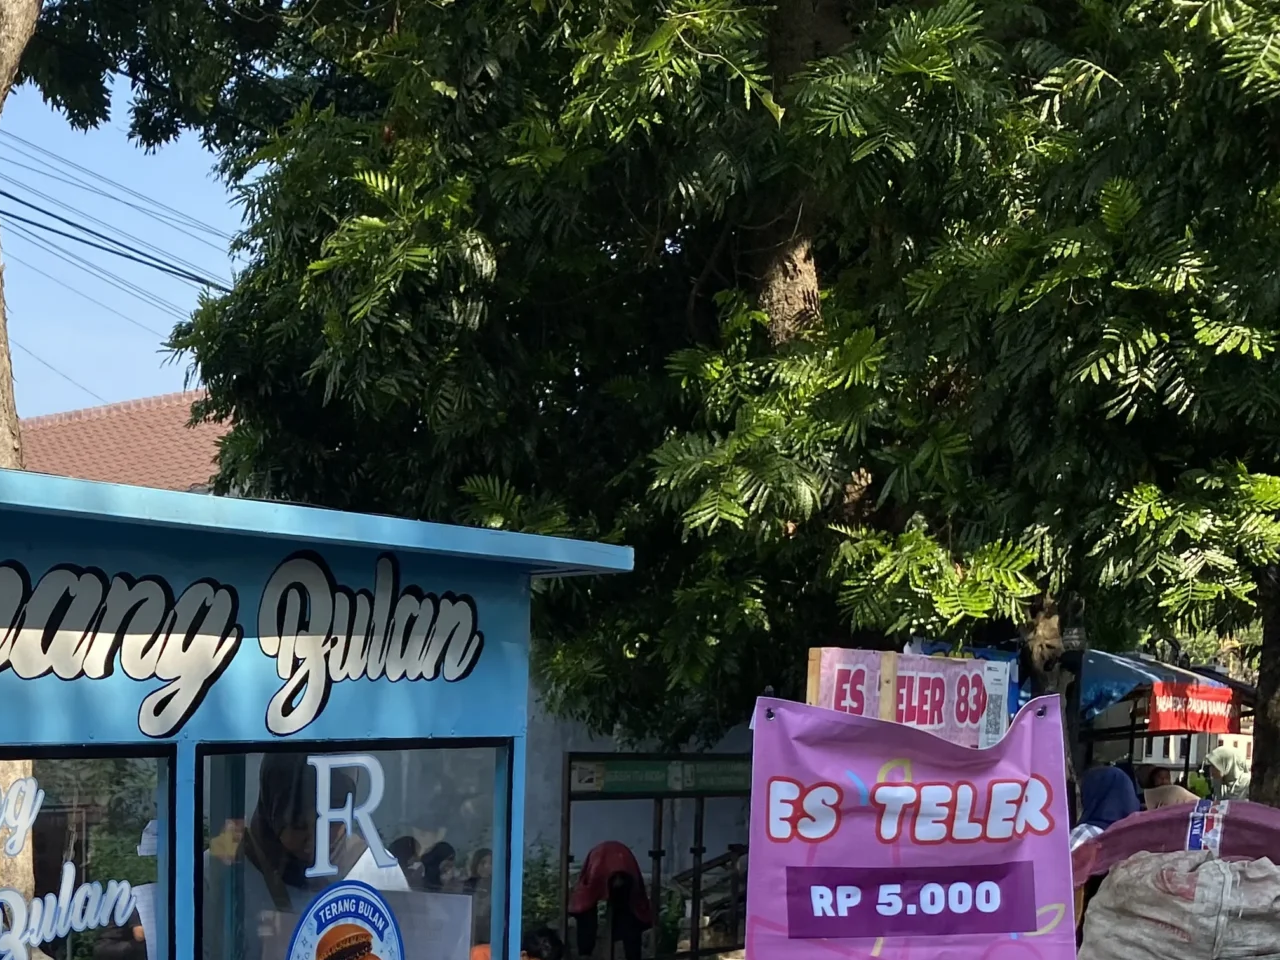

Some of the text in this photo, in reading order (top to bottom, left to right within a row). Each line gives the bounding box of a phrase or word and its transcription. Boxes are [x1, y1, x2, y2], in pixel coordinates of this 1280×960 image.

[257, 550, 484, 736] Bulan
[834, 665, 983, 728] ES ELER 83
[767, 774, 1055, 845] ES TELER
[319, 899, 385, 932] TERANG BULAN
[810, 881, 1001, 917] RP 5.000
